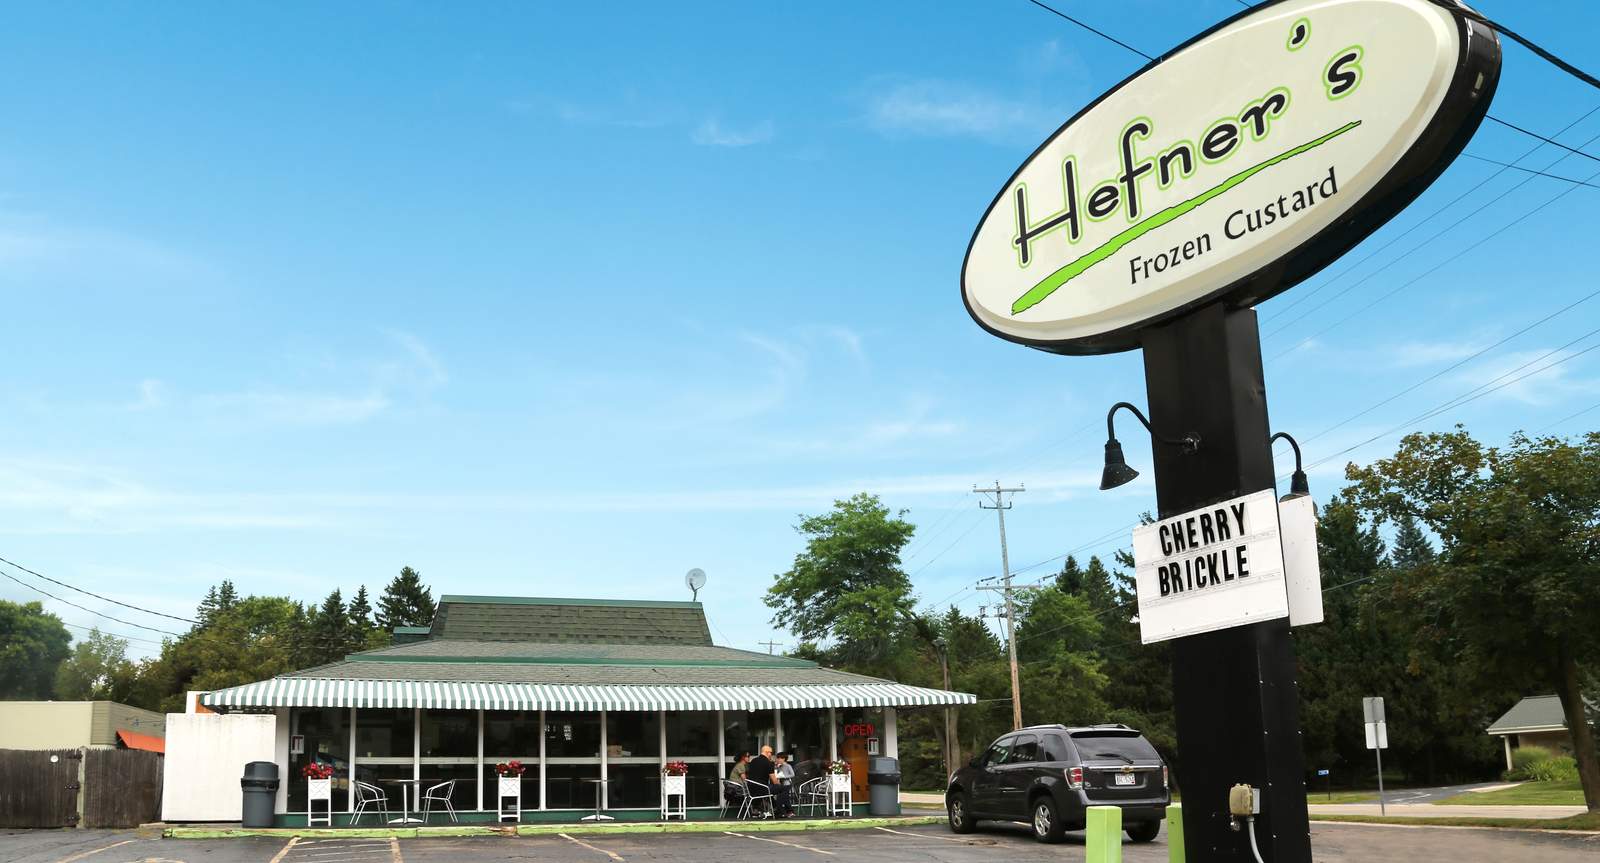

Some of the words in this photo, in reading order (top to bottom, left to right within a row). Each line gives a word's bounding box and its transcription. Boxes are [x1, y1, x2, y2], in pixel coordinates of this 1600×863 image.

[1013, 22, 1359, 265] Hefner's
[1129, 232, 1212, 284] Frozen
[1223, 166, 1339, 240] Custard
[1159, 502, 1245, 556] CHERRY
[1158, 545, 1249, 597] BRICKLE
[844, 723, 874, 736] OPEN
